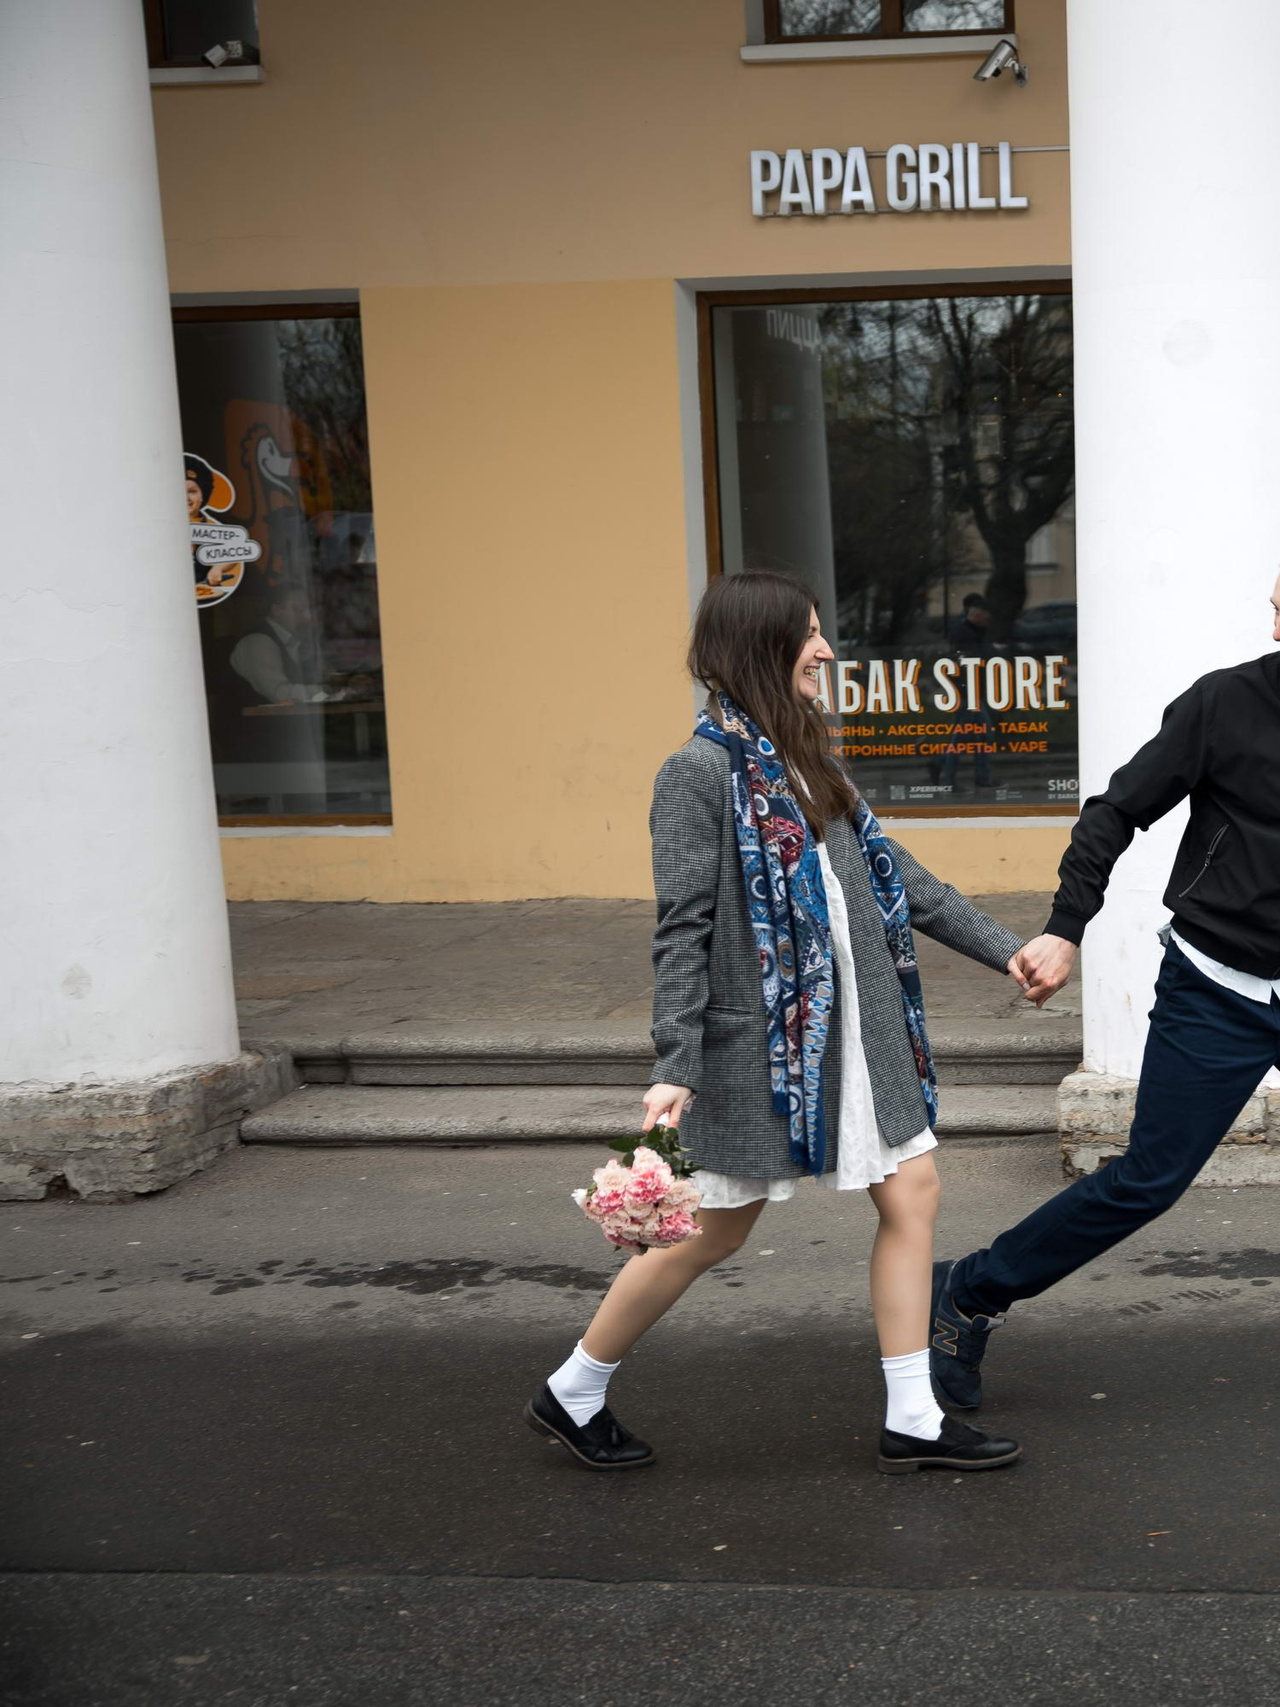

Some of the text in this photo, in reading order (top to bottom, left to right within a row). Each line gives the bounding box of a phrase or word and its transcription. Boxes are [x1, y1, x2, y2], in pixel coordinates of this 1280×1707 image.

[751, 141, 1029, 216] PAPA GRILL
[192, 529, 239, 540] МАСТЕР-
[206, 546, 251, 559] КЛАССЫ
[809, 655, 1069, 715] АБАК STORE
[887, 723, 987, 736] АКСЕССУАРЫ
[998, 721, 1048, 733] ТАБАК
[920, 742, 997, 755] СИГАРЕТЫ
[1008, 741, 1048, 752] VAPE
[1048, 779, 1078, 791] SHO
[932, 1318, 958, 1356] N
